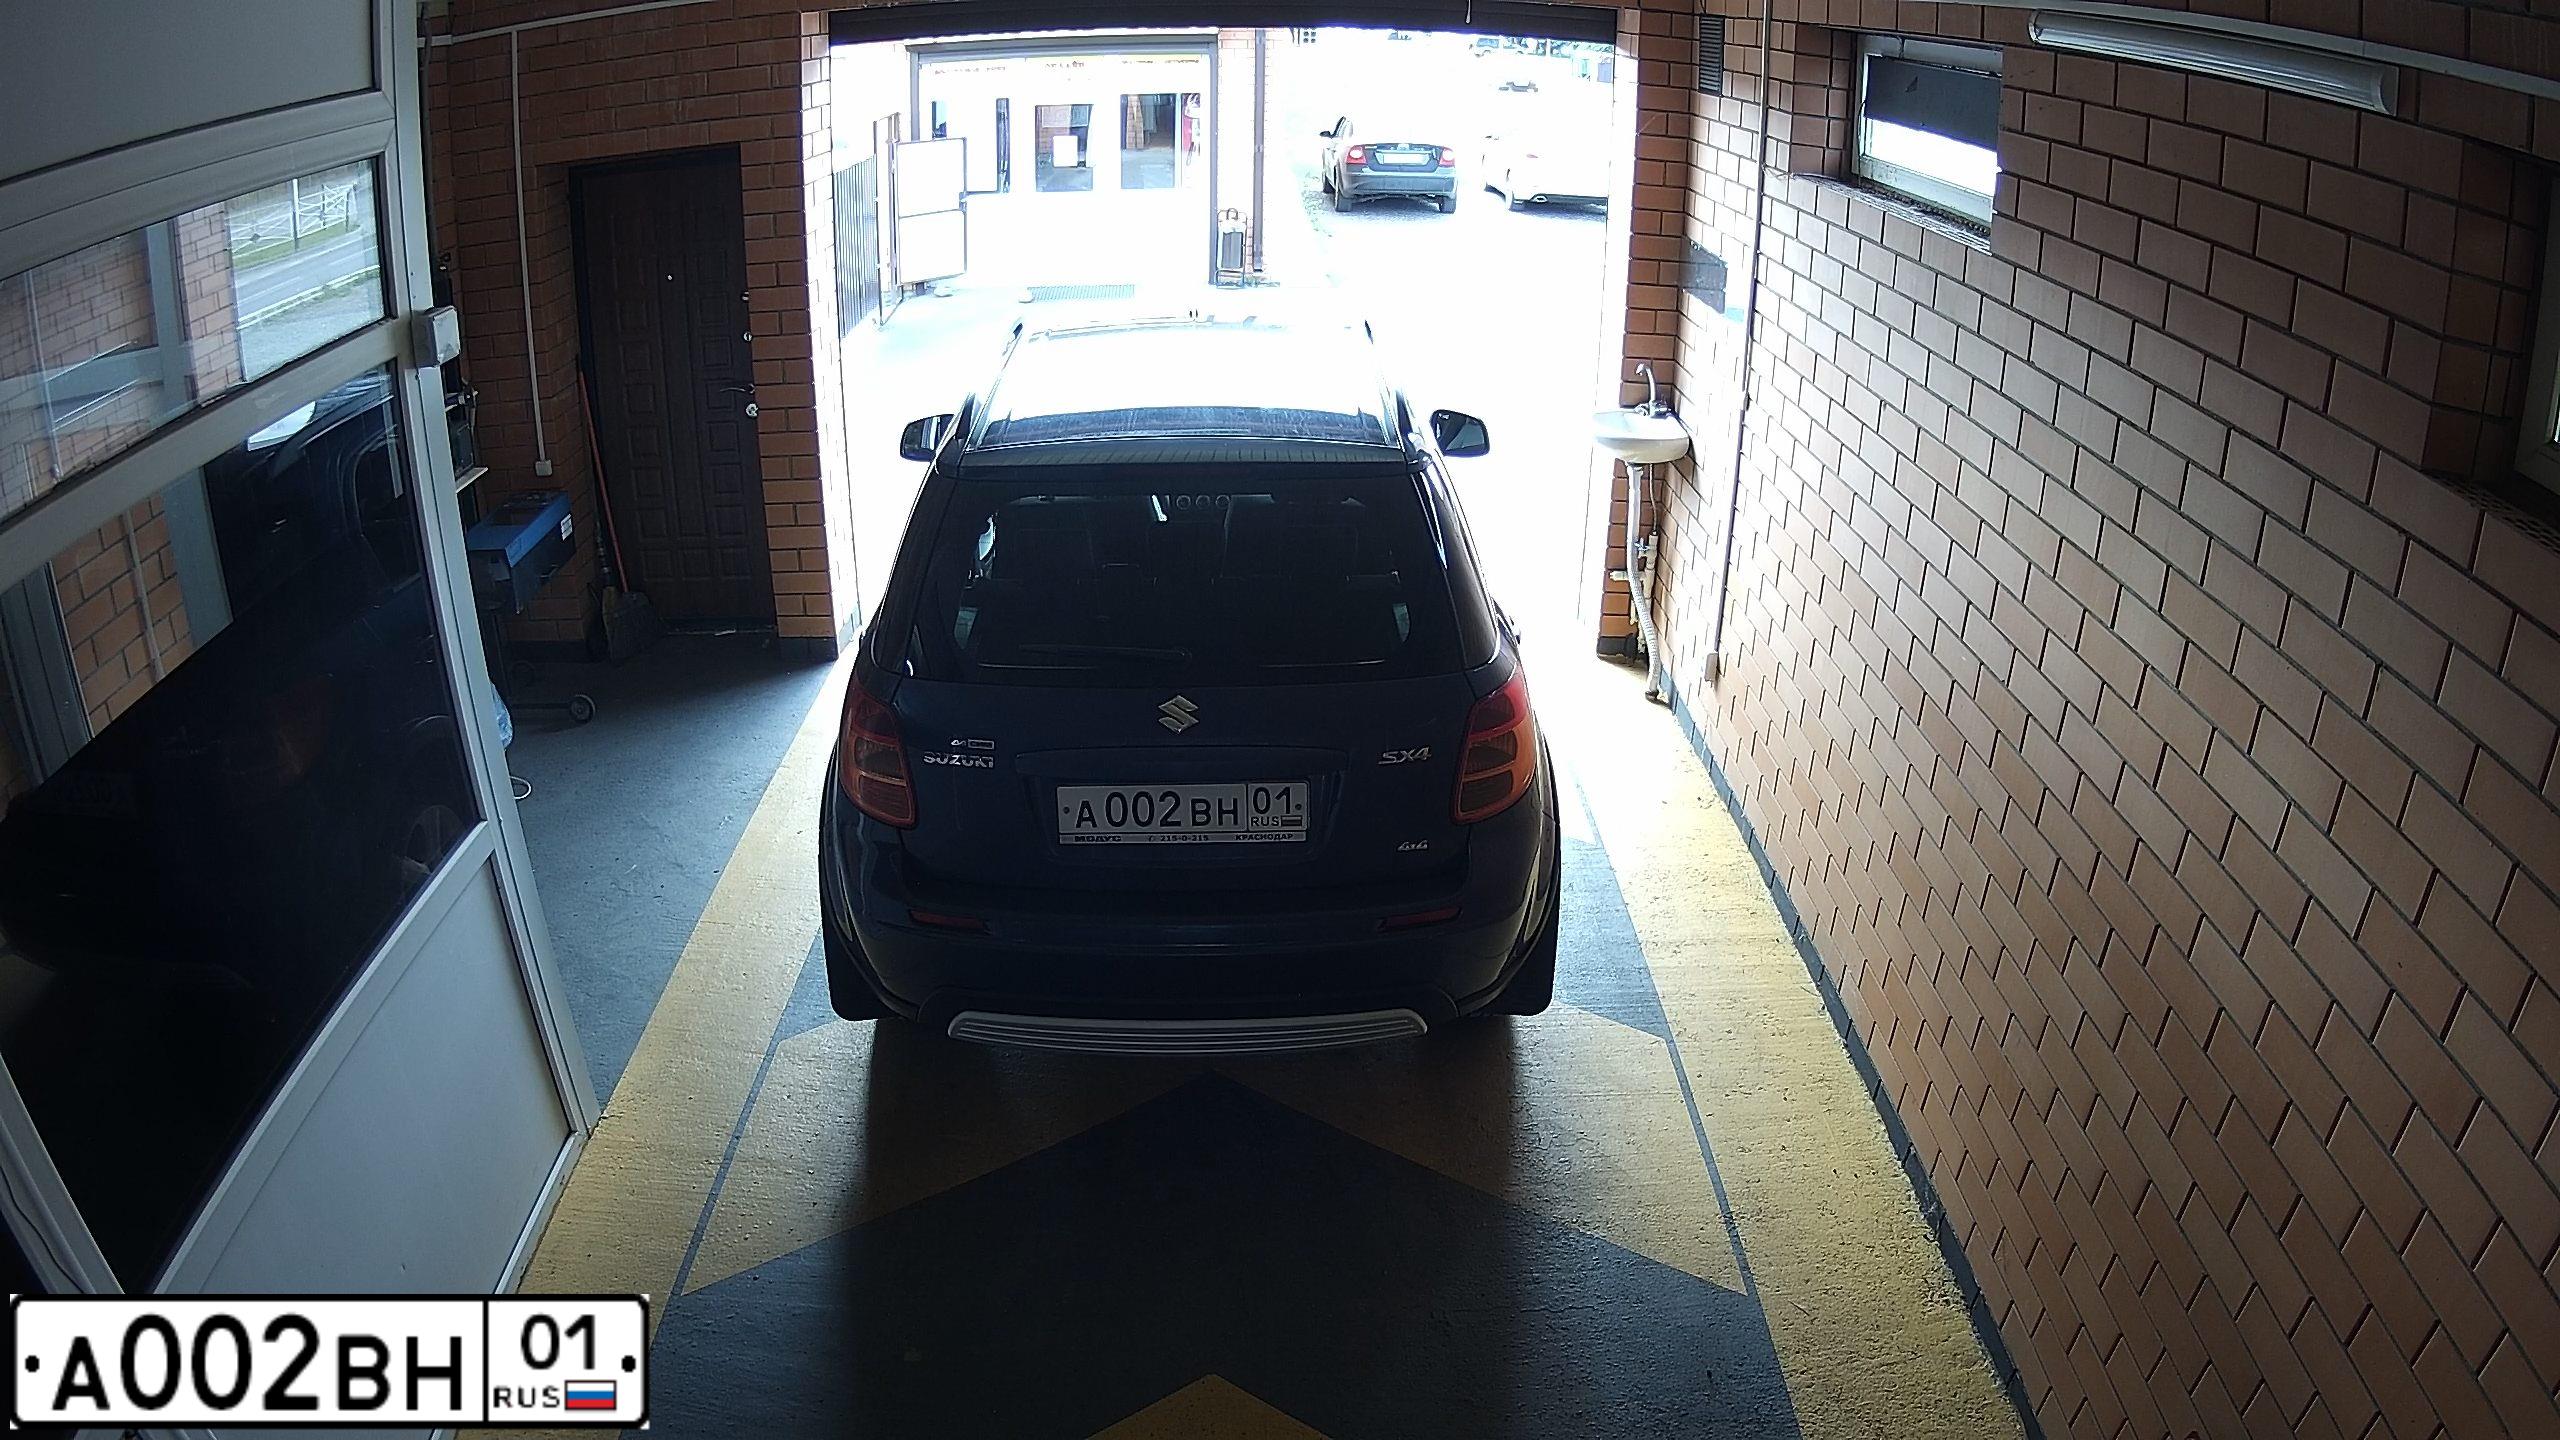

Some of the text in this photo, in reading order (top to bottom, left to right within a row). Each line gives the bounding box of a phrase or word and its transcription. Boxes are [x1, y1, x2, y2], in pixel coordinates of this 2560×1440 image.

[923, 752, 994, 768] SUZUKI
[1378, 746, 1431, 764] SX4
[1252, 786, 1292, 815] 01
[1250, 816, 1280, 827] RUS
[1235, 833, 1293, 841] КРАСНОДАР
